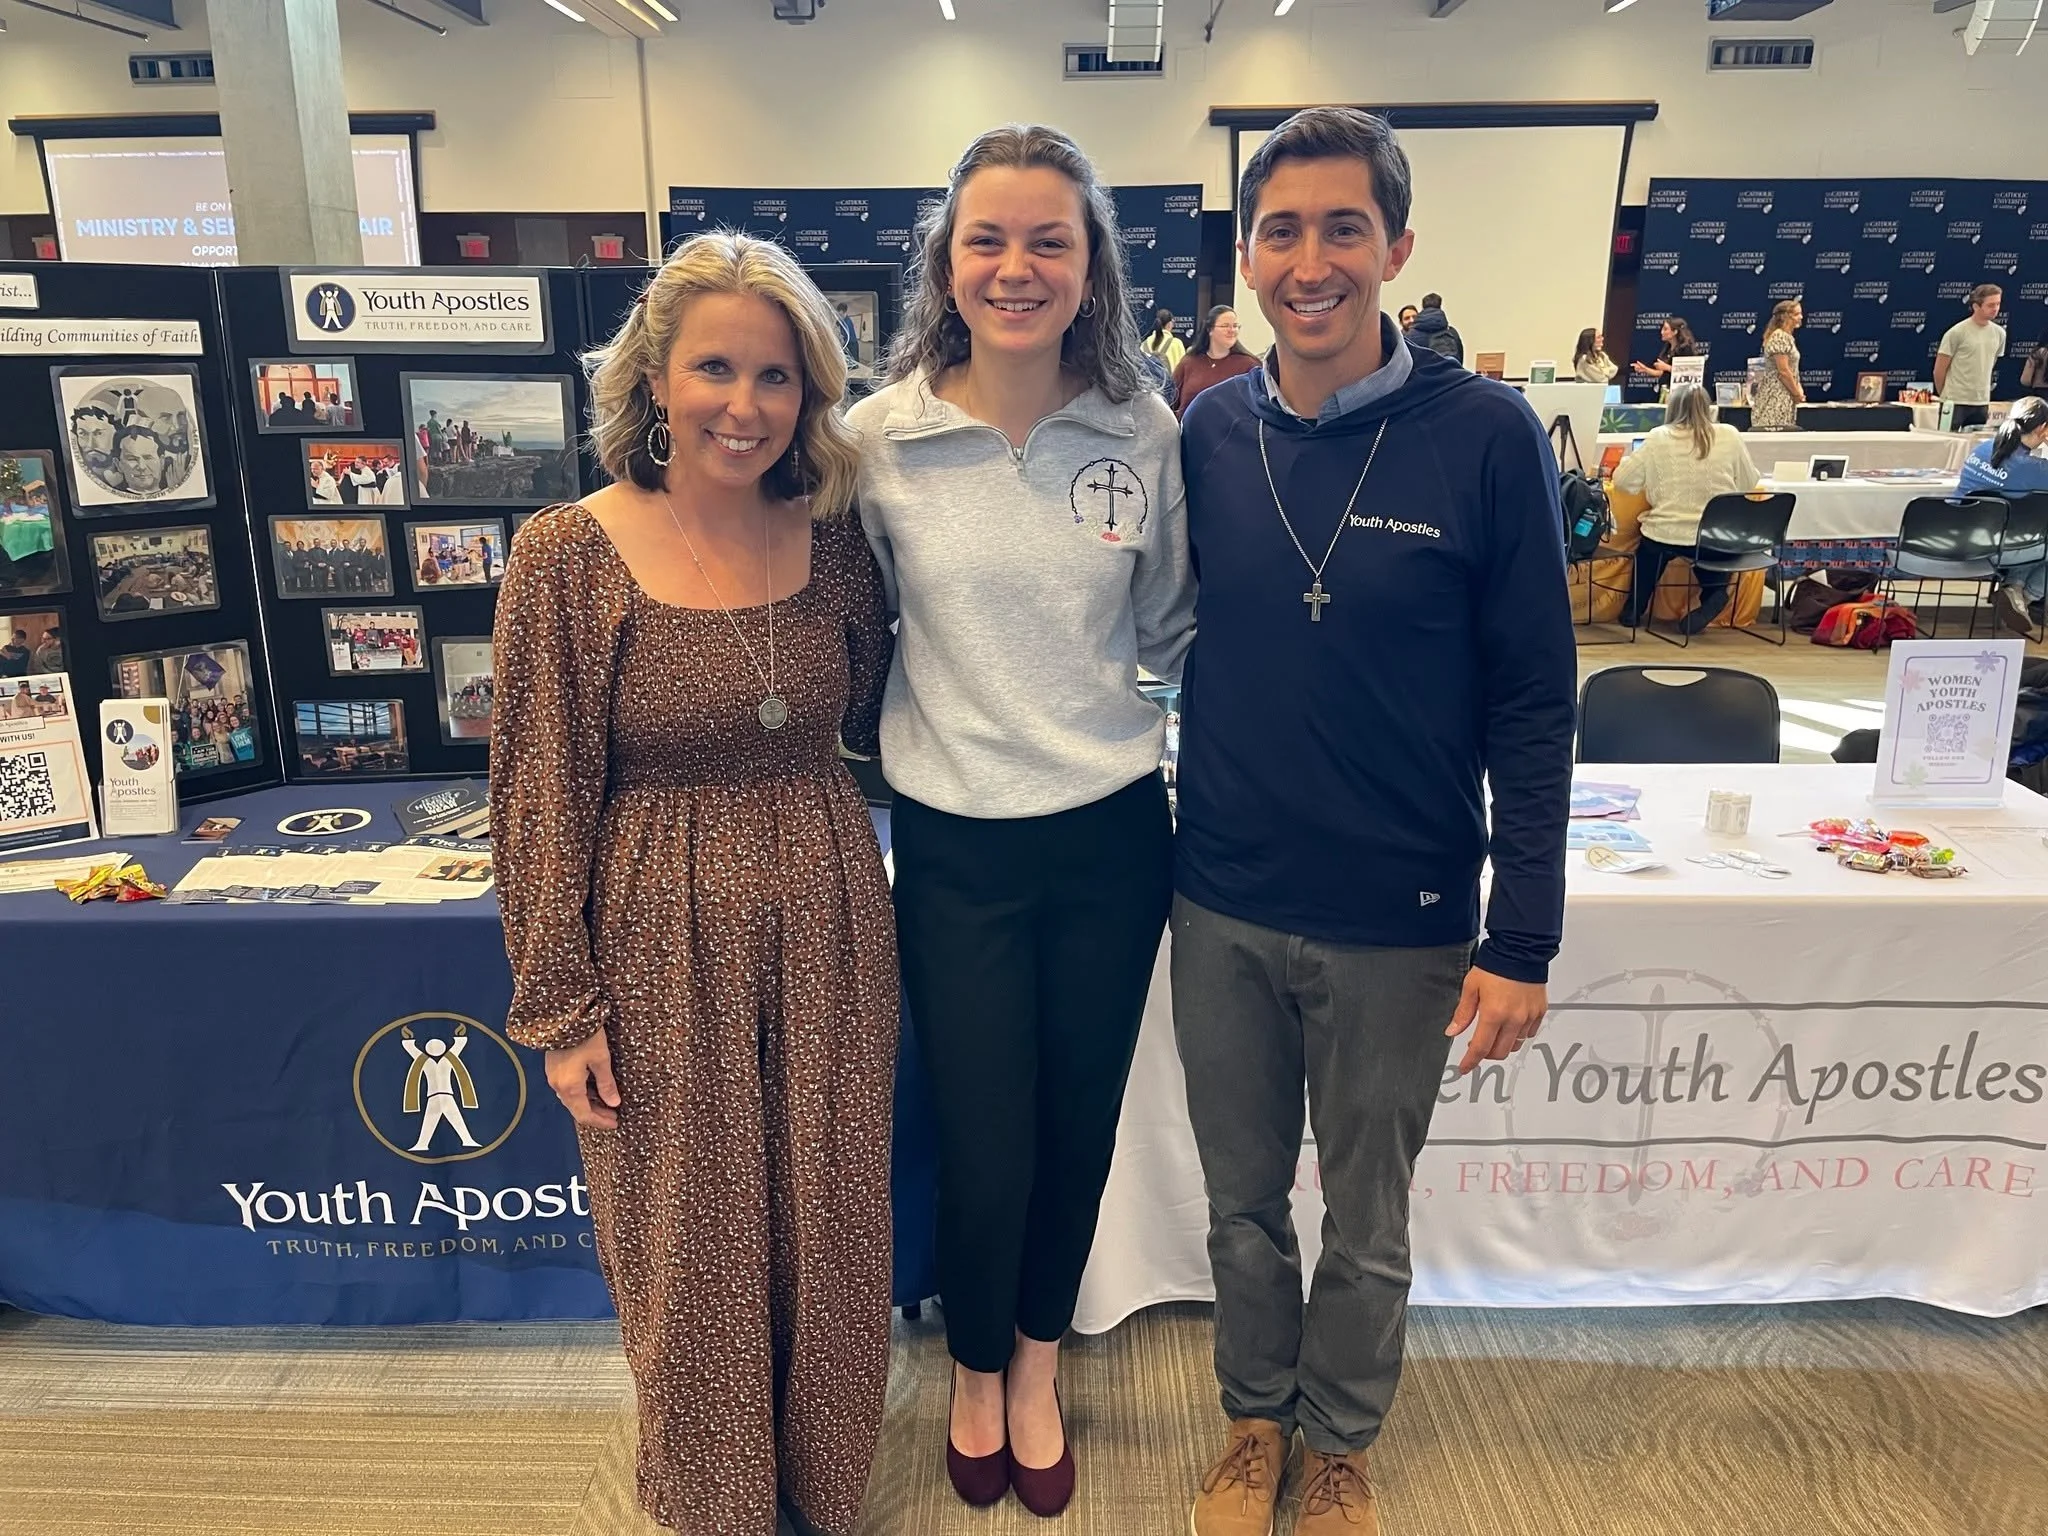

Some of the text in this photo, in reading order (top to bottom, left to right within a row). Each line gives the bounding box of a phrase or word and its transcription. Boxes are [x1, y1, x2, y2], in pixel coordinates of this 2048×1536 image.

[196, 202, 225, 211] BE ON
[76, 218, 178, 236] MINISTRY
[184, 218, 198, 236] &
[362, 291, 529, 314] Youth Apostles
[364, 321, 531, 332] TRUTH, FREEDOM, AND CARE
[48, 329, 138, 343] Communities
[142, 329, 158, 346] of
[160, 329, 198, 343] Faith
[1349, 514, 1441, 538] Youth Apostles
[1928, 675, 1982, 686] WOMEN
[1930, 687, 1977, 698] YOUTH
[1916, 699, 1987, 713] APOSTLES
[110, 778, 139, 788] Youth
[110, 787, 156, 798] Apostles
[428, 838, 457, 847] The
[1532, 1032, 1729, 1104] Youth
[1747, 1030, 2047, 1124] Apostles
[1456, 1157, 1734, 1200] FREEDOM,
[1758, 1157, 1869, 1191] AND
[1894, 1156, 2036, 1198] CARE
[220, 1180, 396, 1232] Youth
[266, 1240, 360, 1259] TRUTH,
[368, 1236, 505, 1258] FREEDOM,
[513, 1233, 567, 1252] AND
